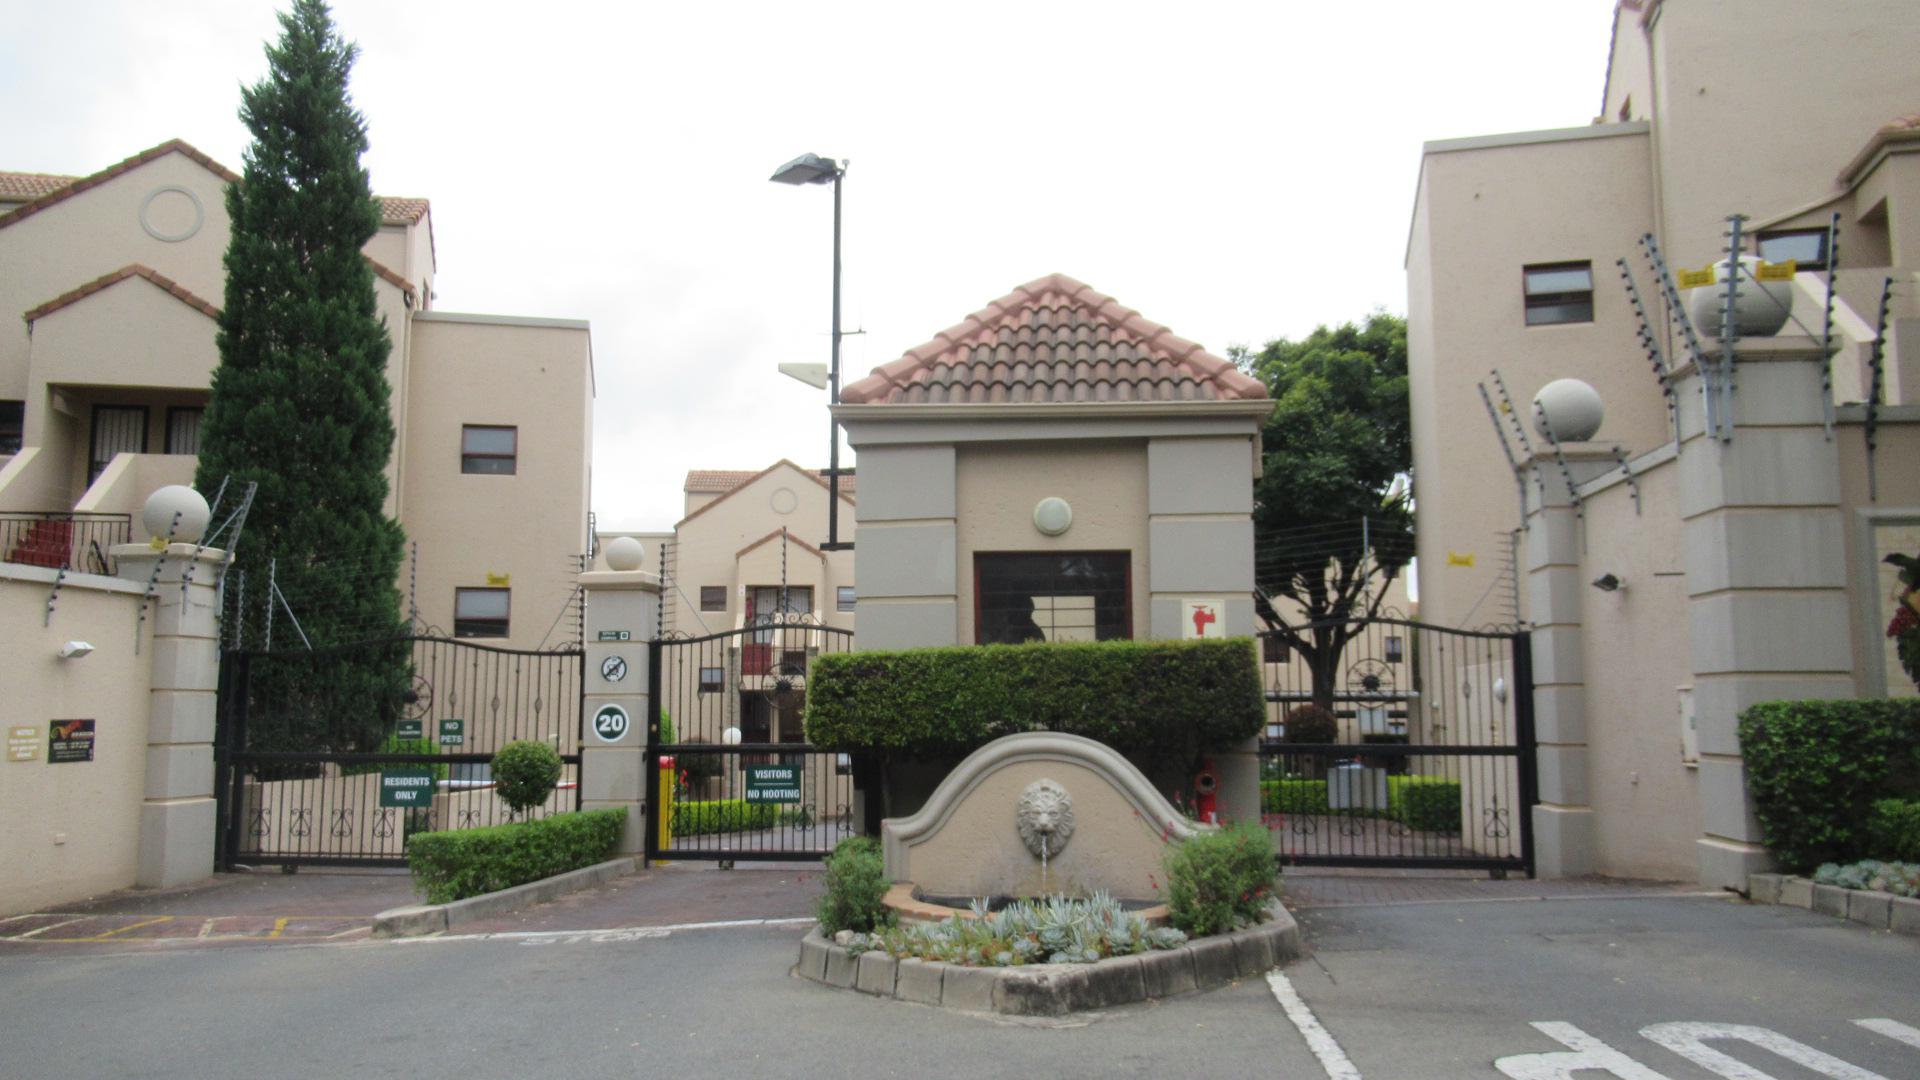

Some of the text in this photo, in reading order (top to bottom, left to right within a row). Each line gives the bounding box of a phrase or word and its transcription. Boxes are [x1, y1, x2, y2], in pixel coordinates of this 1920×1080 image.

[445, 721, 459, 730] NO
[598, 714, 624, 731] 20
[440, 735, 462, 743] PETS
[755, 769, 793, 779] VISITORS
[384, 777, 430, 786] RESIDENTS
[395, 791, 418, 800] ONLY
[747, 789, 800, 799] NO HOOTING
